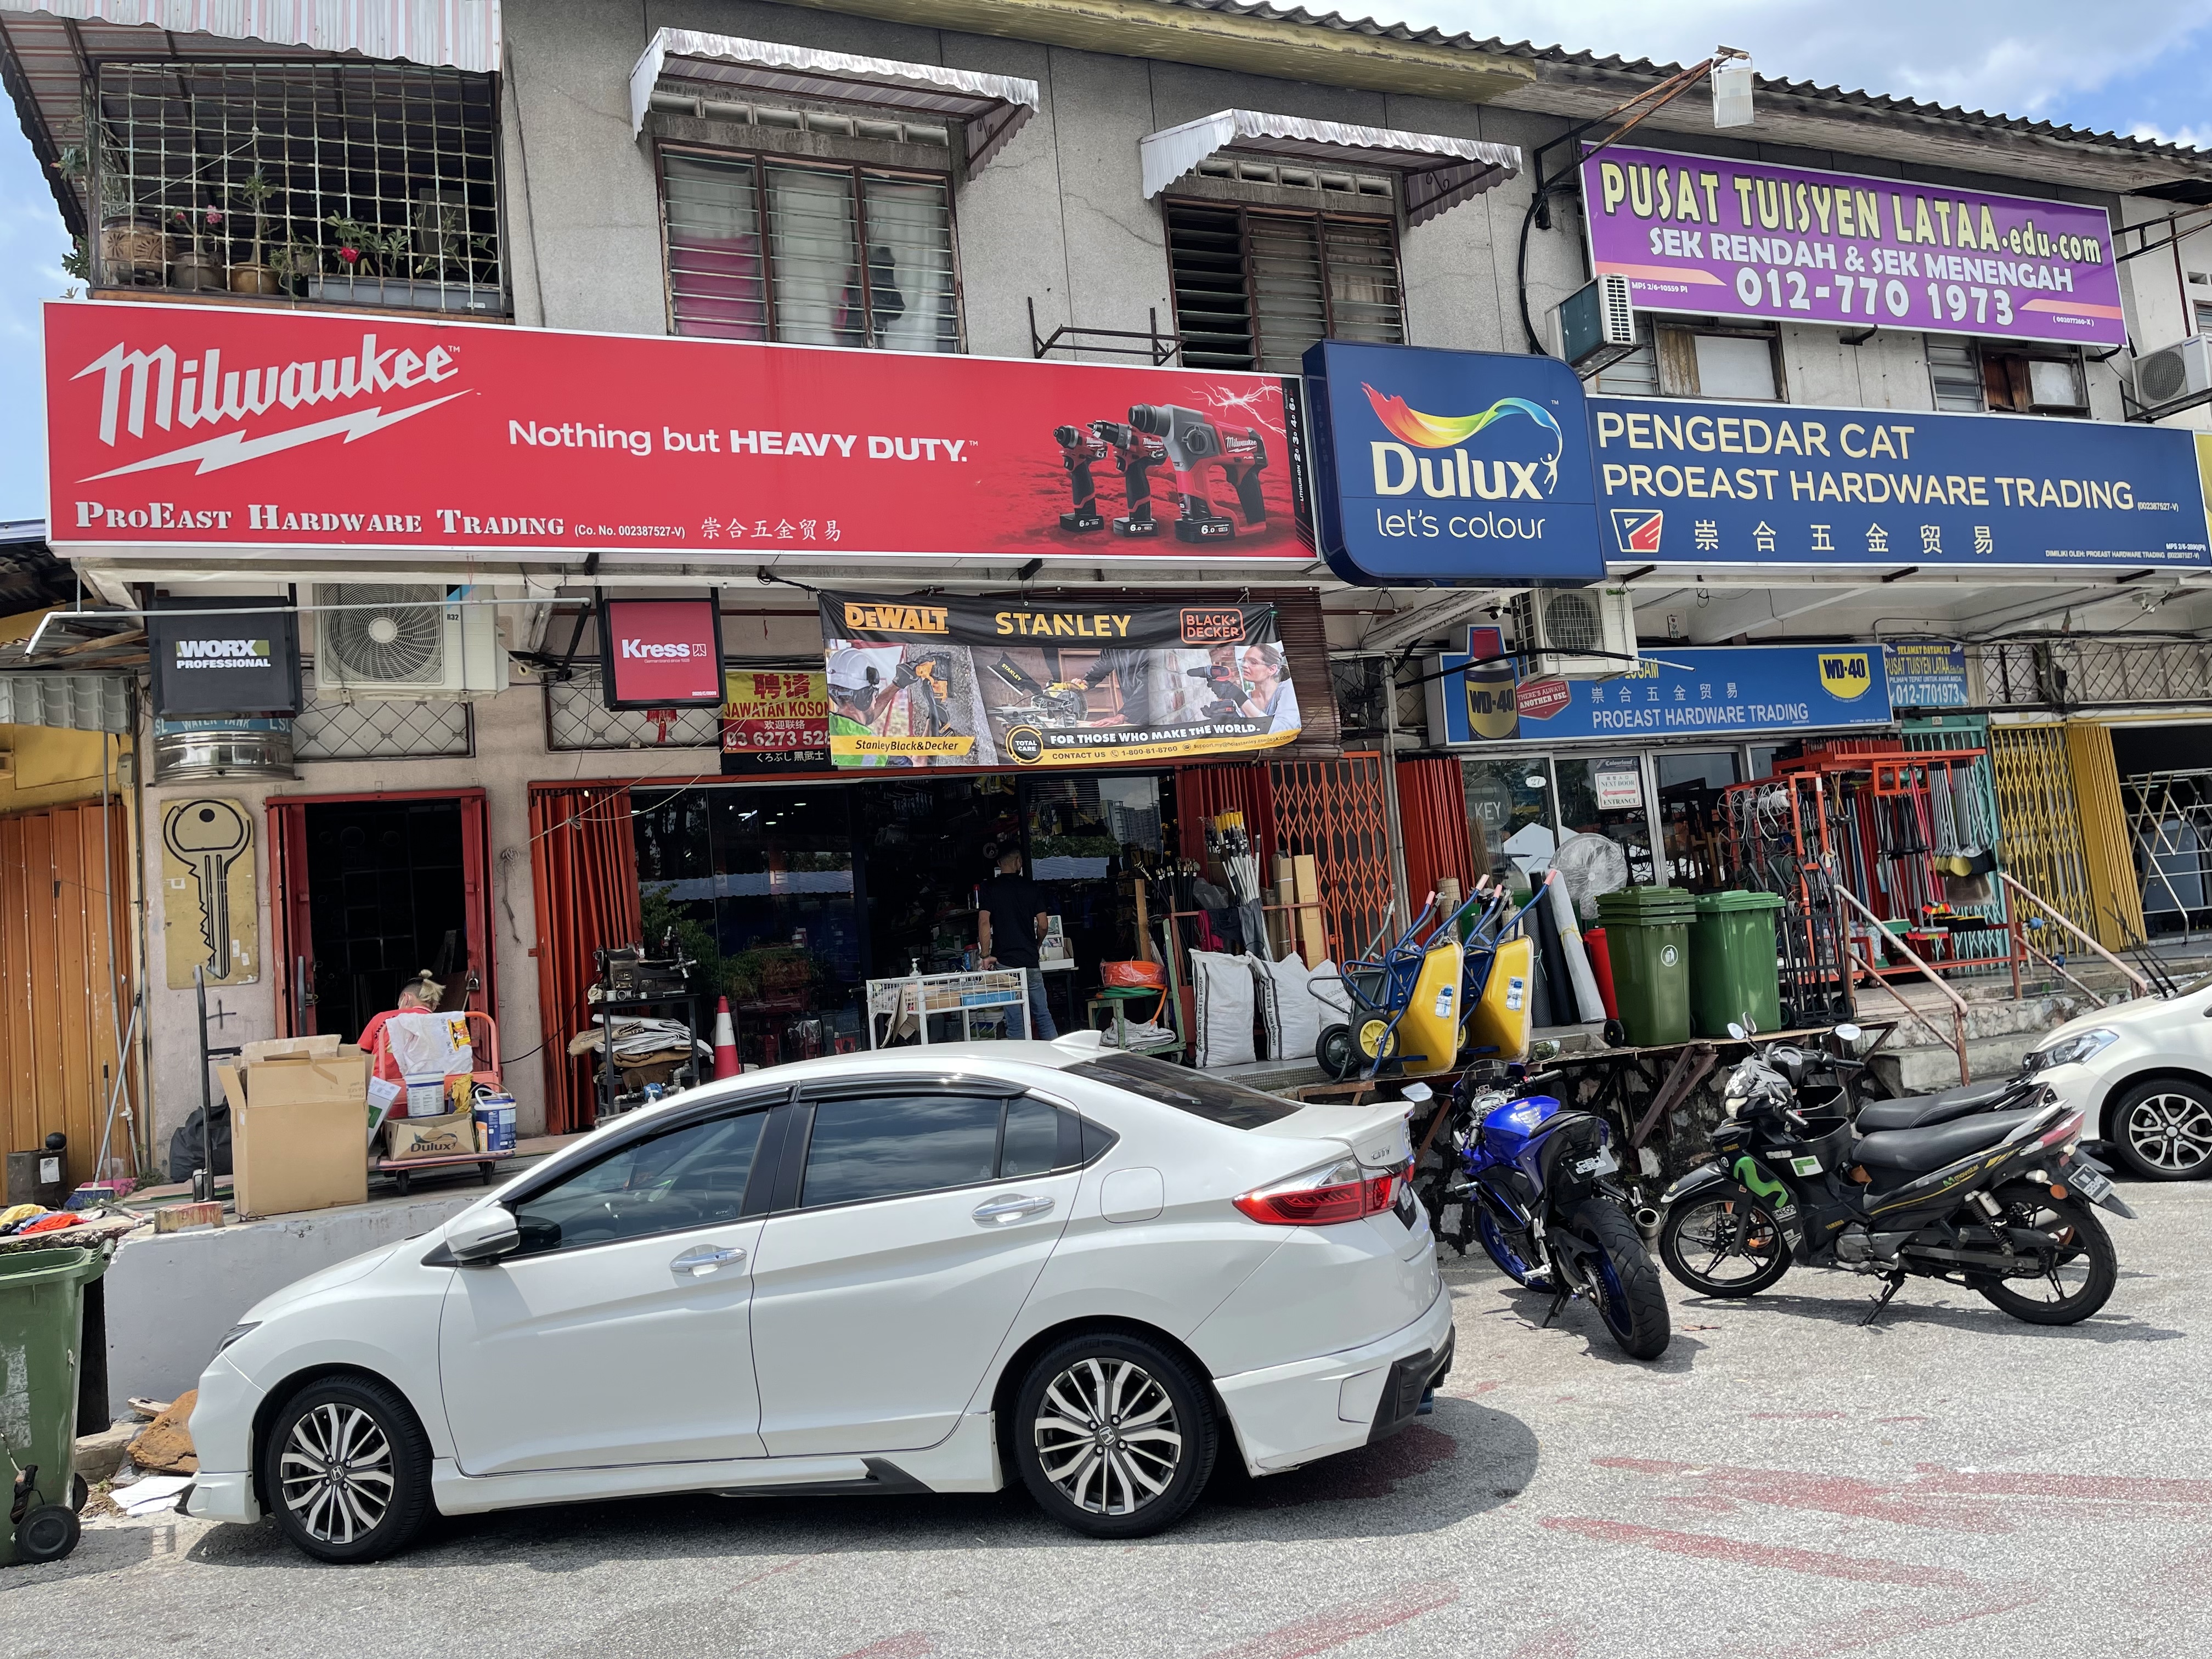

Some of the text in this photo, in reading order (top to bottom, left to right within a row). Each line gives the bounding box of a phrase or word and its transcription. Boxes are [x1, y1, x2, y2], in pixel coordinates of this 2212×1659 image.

[1600, 161, 2102, 264] PUSAT TUISYEN LATAA.edu.com
[1649, 227, 2074, 292] SEK RENDAH & SEK MENENGAH
[1631, 281, 1646, 290] MPS
[1736, 267, 2015, 325] 012-770 1973
[68, 334, 459, 447] Milwaukee
[508, 420, 652, 456] Nothing
[663, 426, 721, 453] but
[730, 429, 860, 459] HEAVY
[867, 436, 968, 463] DUTY.
[1225, 436, 1257, 449] Milwaukee
[1596, 411, 1915, 460] PENGEDAR CAT
[1370, 441, 1544, 500] Dulux
[1602, 464, 1780, 501] PROEAST
[1790, 470, 1990, 507] HARDWARE
[1994, 477, 2134, 511] TRADING
[598, 523, 617, 539] No.
[618, 524, 686, 540] 002387527-V)
[700, 517, 842, 543] 崇合五金贸易
[1376, 508, 1546, 539] let's colour
[1694, 519, 1994, 555] 崇合五金贸易
[844, 605, 948, 632] DEWALT
[995, 611, 1131, 637] STANLEY
[1186, 614, 1237, 627] BLACK+
[1187, 626, 1240, 639] DECKER
[178, 640, 257, 658] WORX
[621, 639, 691, 658] Kress
[176, 658, 271, 669] PROFESSIONAL
[1000, 662, 1022, 682] STANLEY
[1822, 658, 1866, 679] WD-40
[1885, 657, 1905, 675] PUSAT
[1906, 657, 1932, 675] TUISYEN
[752, 673, 810, 699] 聘请
[1517, 684, 1565, 701] THERE'S ALWAYS
[1591, 681, 1739, 704] 崇合五金贸易
[1895, 683, 1960, 705] 012-7701973
[725, 701, 785, 718] JAWATAN
[1469, 688, 1515, 714] WD-40
[1519, 694, 1553, 709] ANOTHER
[764, 719, 805, 730] 欢迎联络
[1593, 702, 1809, 729] PROEAST HARDWARE TRADING
[726, 731, 748, 747] 03
[753, 730, 797, 747] 6273
[1050, 724, 1261, 745] FOR THOSE WHO MAKE THE WORLD.
[855, 739, 959, 752] StanleyBlack&Decker
[1121, 745, 1178, 757] 1-800-81-8760
[756, 752, 792, 763] くろぶし
[1474, 801, 1501, 821] KEY
[1603, 798, 1638, 806] ENTRANCE
[411, 1142, 451, 1153] Dulux
[1371, 1145, 1391, 1161] CITY
